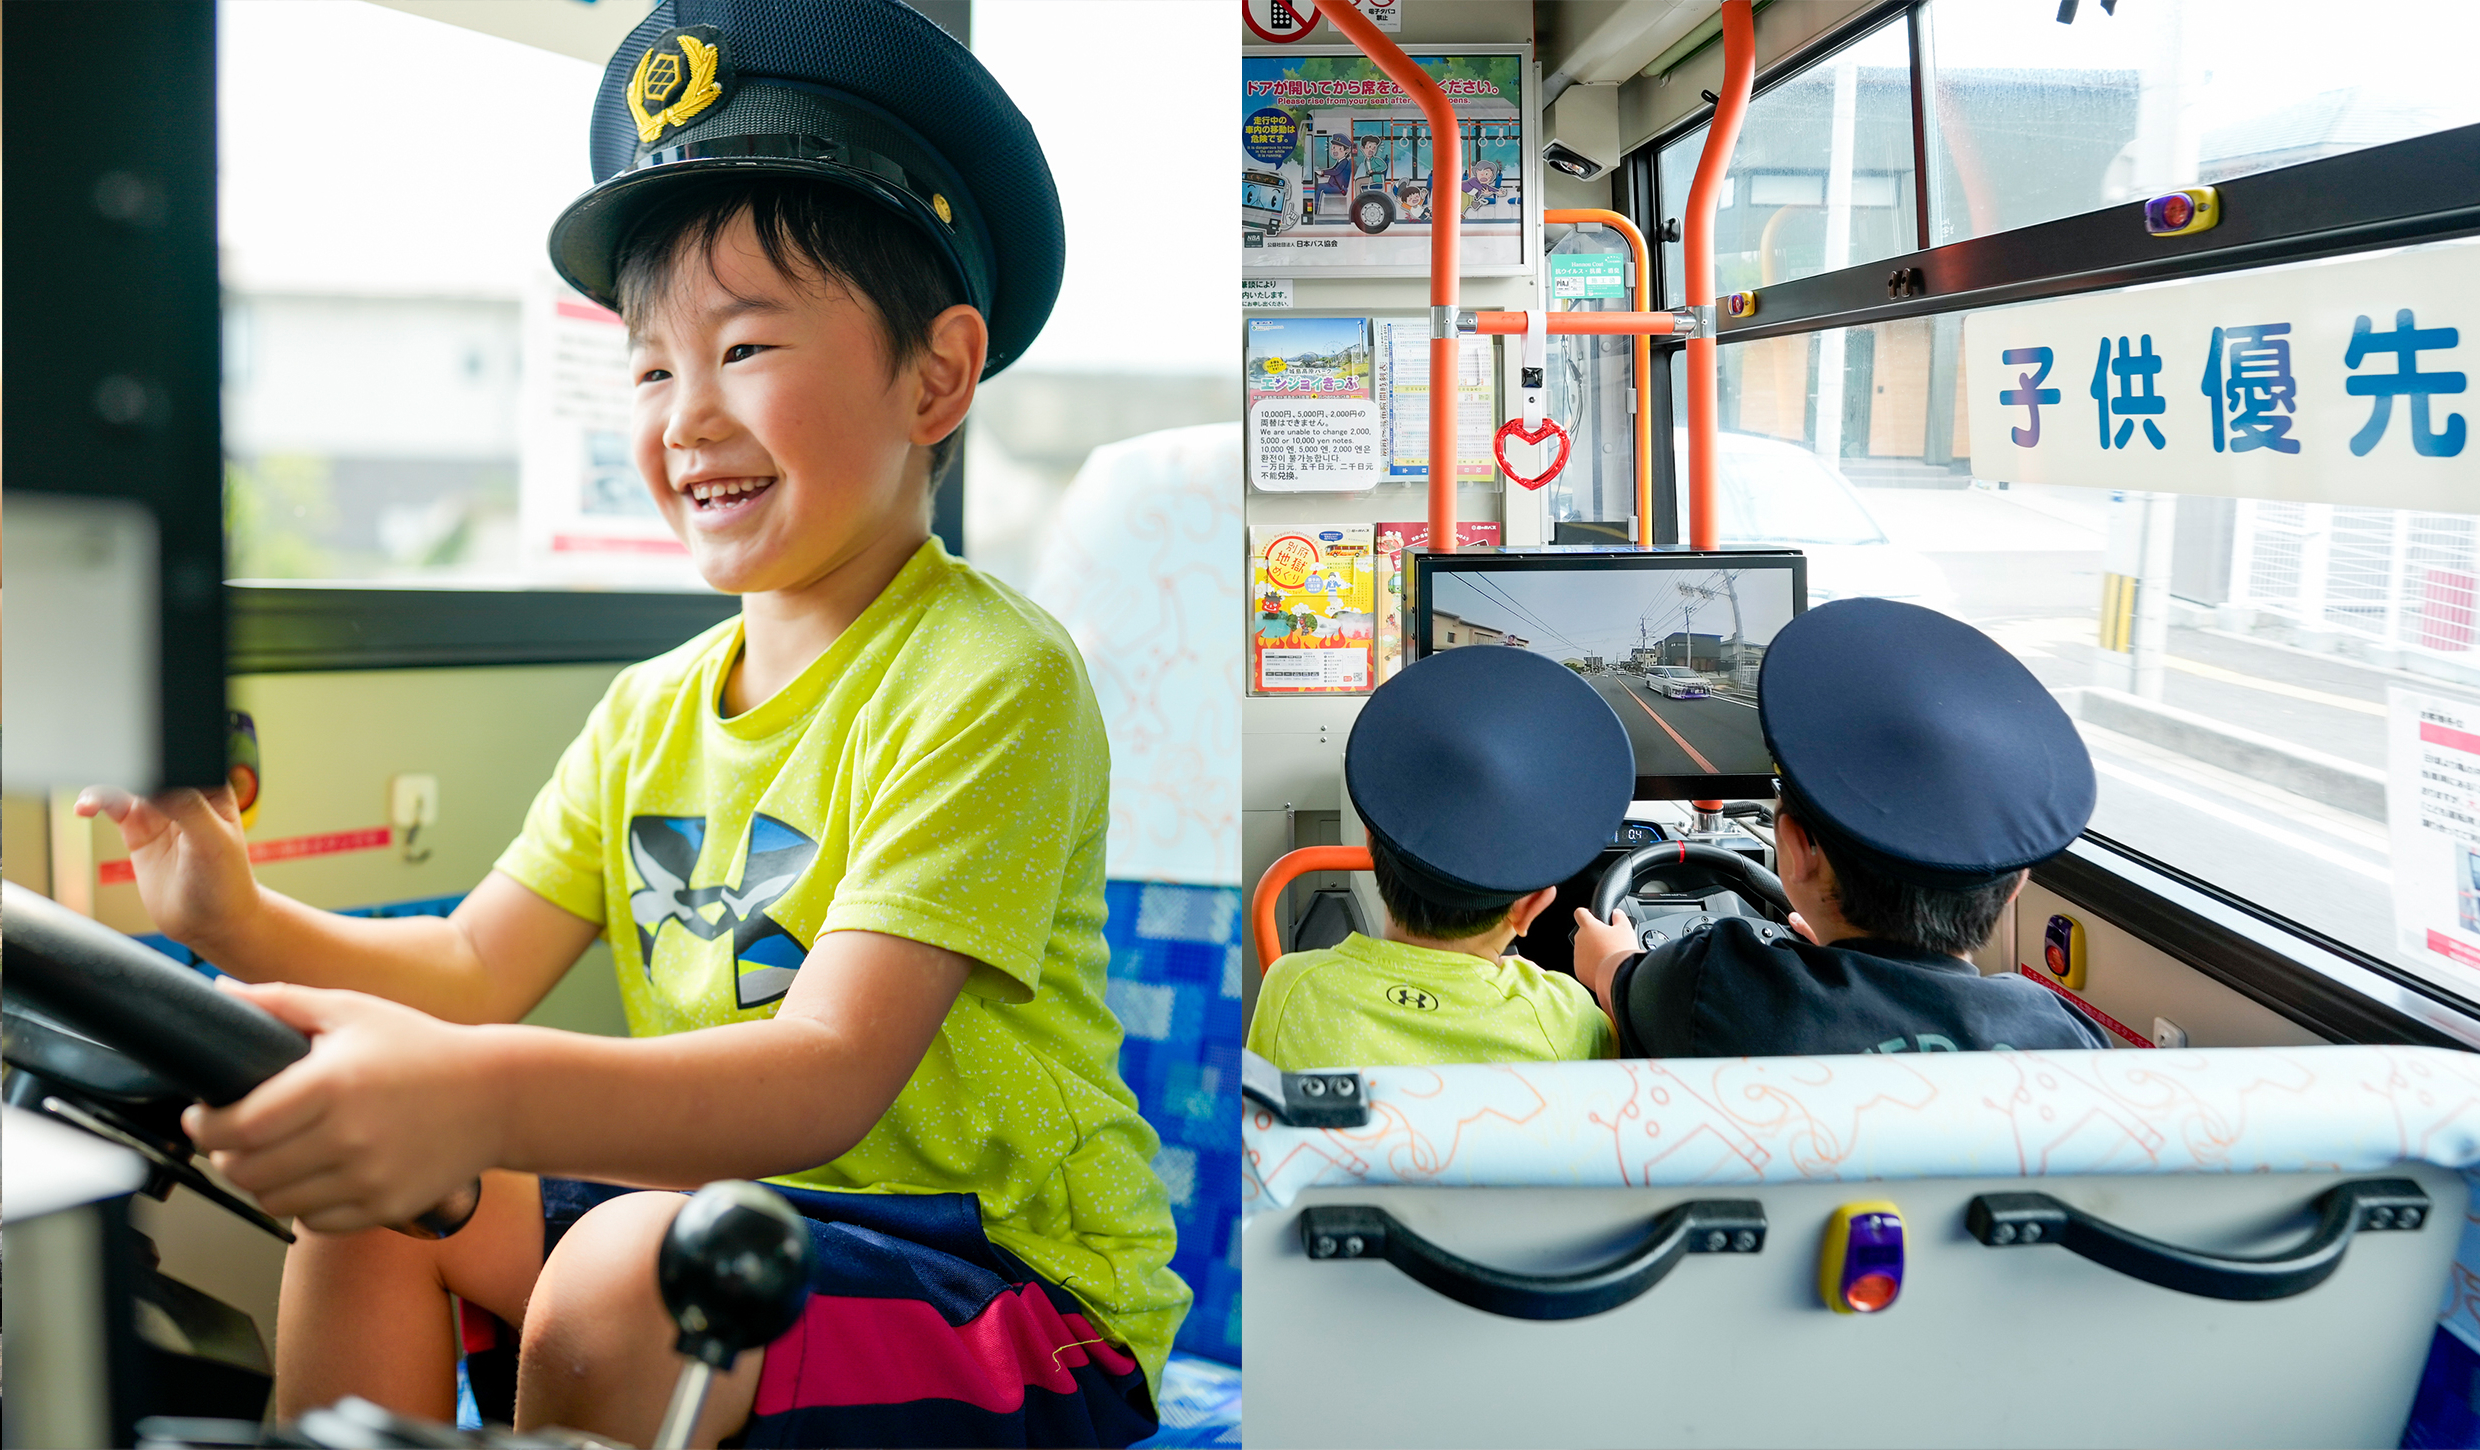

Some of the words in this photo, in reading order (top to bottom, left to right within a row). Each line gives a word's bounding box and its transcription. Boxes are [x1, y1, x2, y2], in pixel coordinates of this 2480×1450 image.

[1246, 80, 1499, 96] ドアが開いてから席をおください。
[1277, 97, 1305, 105] Please
[1307, 97, 1324, 105] rise
[1327, 97, 1346, 105] from
[1349, 97, 1368, 106] your
[1370, 97, 1389, 105] seat
[1390, 97, 1411, 105] after
[1449, 97, 1471, 106] pens.
[1253, 116, 1287, 125] 走行中の
[1245, 125, 1295, 134] 車内の移動は
[1250, 134, 1289, 143] 危険です。
[1296, 240, 1338, 248] 日本バス協会
[1260, 375, 1360, 392] エンジョイきっぷ
[1999, 308, 2468, 458] 子供優先
[1260, 419, 1329, 427] 両替はできません。
[1322, 428, 1348, 436] change
[1260, 437, 1279, 445] 5,000
[1292, 437, 1315, 445] 10,000
[1318, 438, 1330, 446] yen
[1261, 446, 1284, 454] 10,000
[1298, 446, 1318, 454] 5,000
[1333, 446, 1352, 454] 2,000
[1261, 454, 1286, 463] 환전이
[1286, 541, 1310, 558] 別府
[1275, 550, 1308, 574] 地獄
